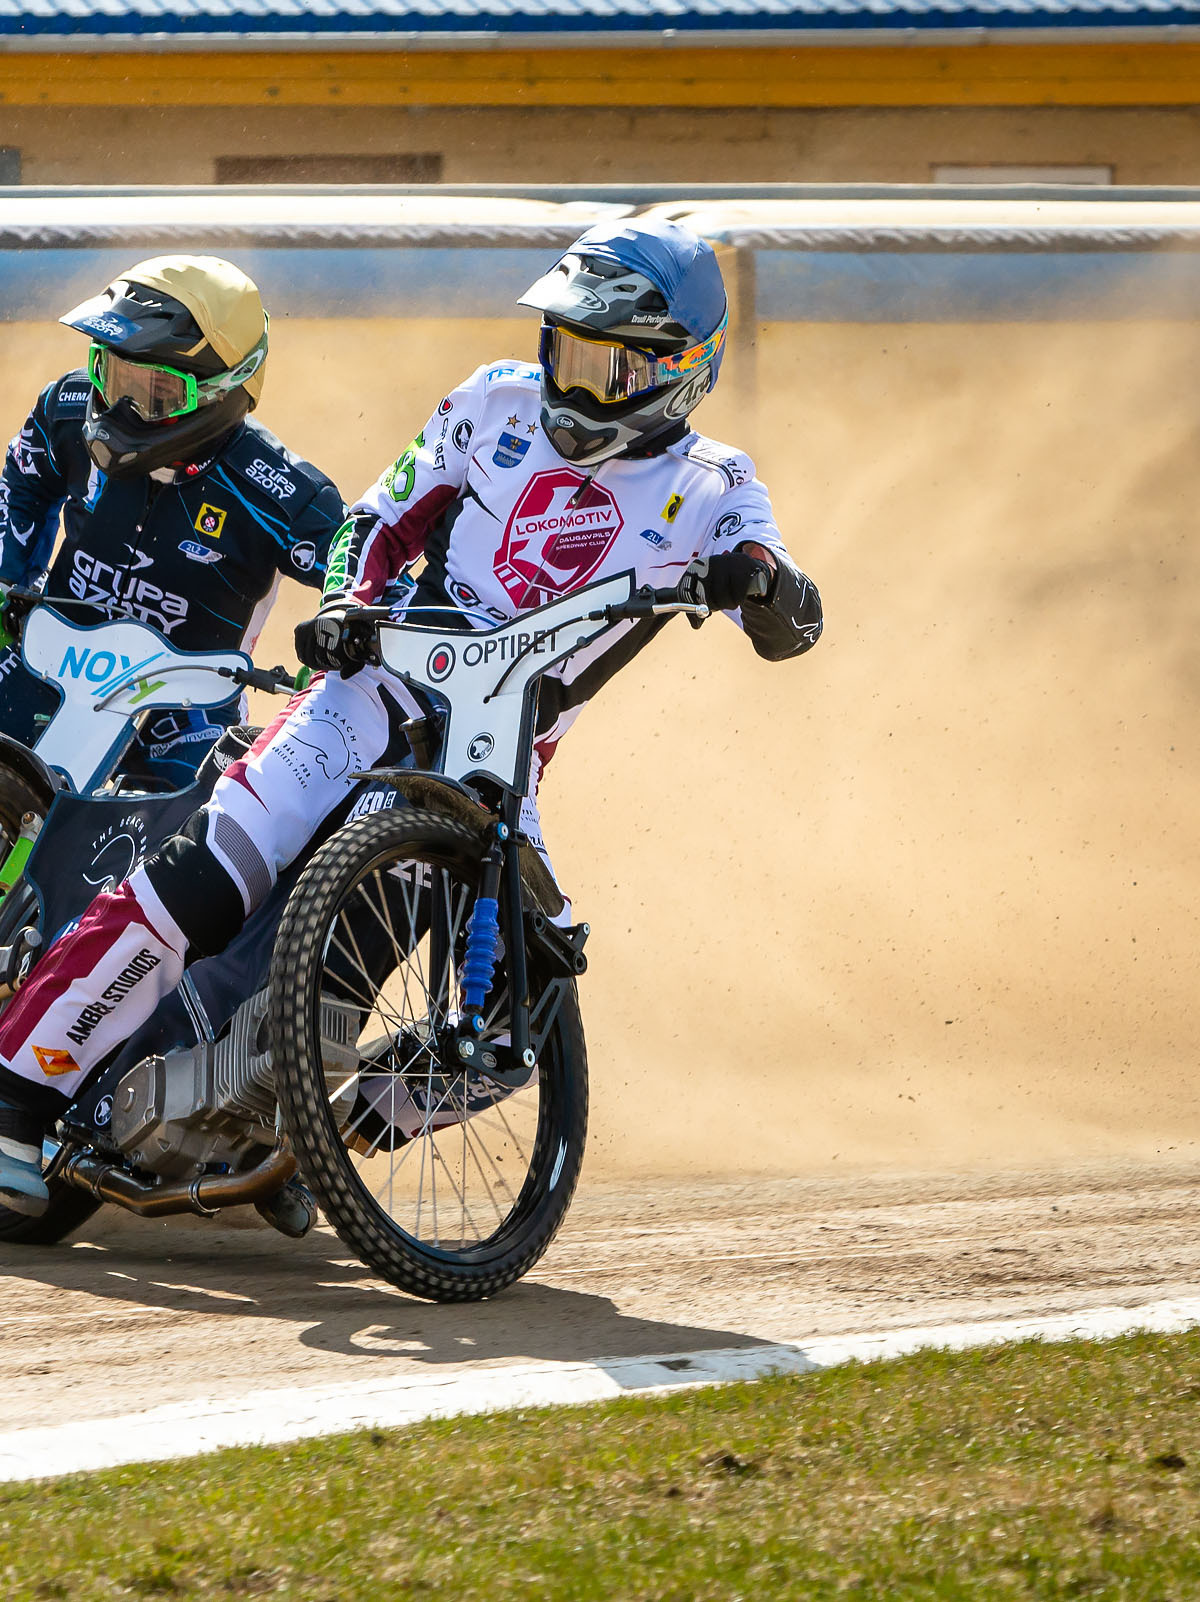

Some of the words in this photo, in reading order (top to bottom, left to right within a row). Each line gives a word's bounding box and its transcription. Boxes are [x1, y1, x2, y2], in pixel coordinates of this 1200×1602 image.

[486, 368, 541, 382] TRO
[515, 510, 613, 536] LOKOMOTIV
[559, 531, 611, 543] DAUGAVPILS
[462, 629, 560, 667] OPTIBET
[324, 709, 357, 742] BEACH
[92, 825, 113, 849] THE
[119, 815, 145, 833] BEACH
[66, 1001, 117, 1047] AMBER
[100, 948, 162, 1003] STUDIOS
